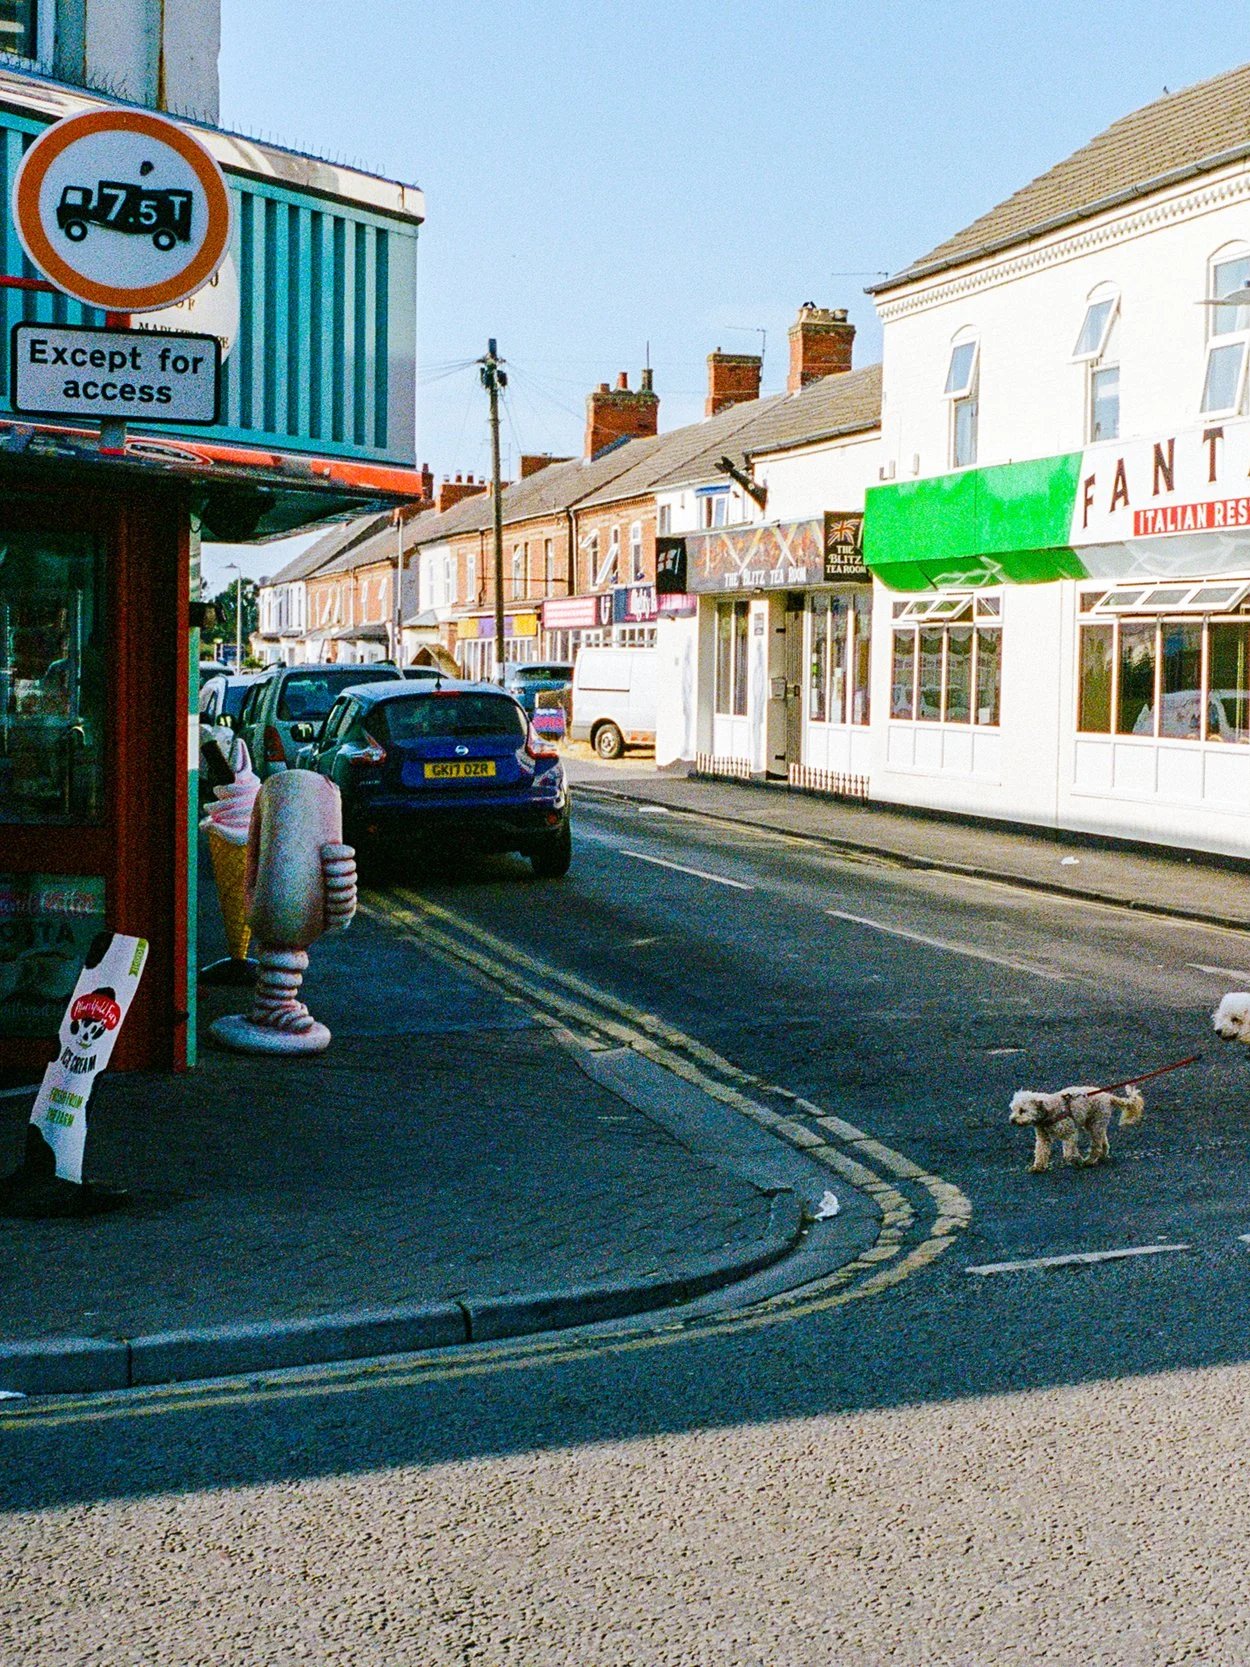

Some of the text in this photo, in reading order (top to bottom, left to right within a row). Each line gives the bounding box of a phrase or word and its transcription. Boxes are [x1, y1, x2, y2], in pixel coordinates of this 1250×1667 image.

[29, 339, 204, 374] Except for
[63, 380, 172, 403] access
[1138, 504, 1208, 535] ITALIAN
[837, 545, 854, 554] THE
[828, 554, 863, 565] BLITZ
[724, 566, 808, 587] THE BLITZ TEA ROOM
[826, 564, 867, 574] TEA ROOM
[432, 763, 461, 776] GK17
